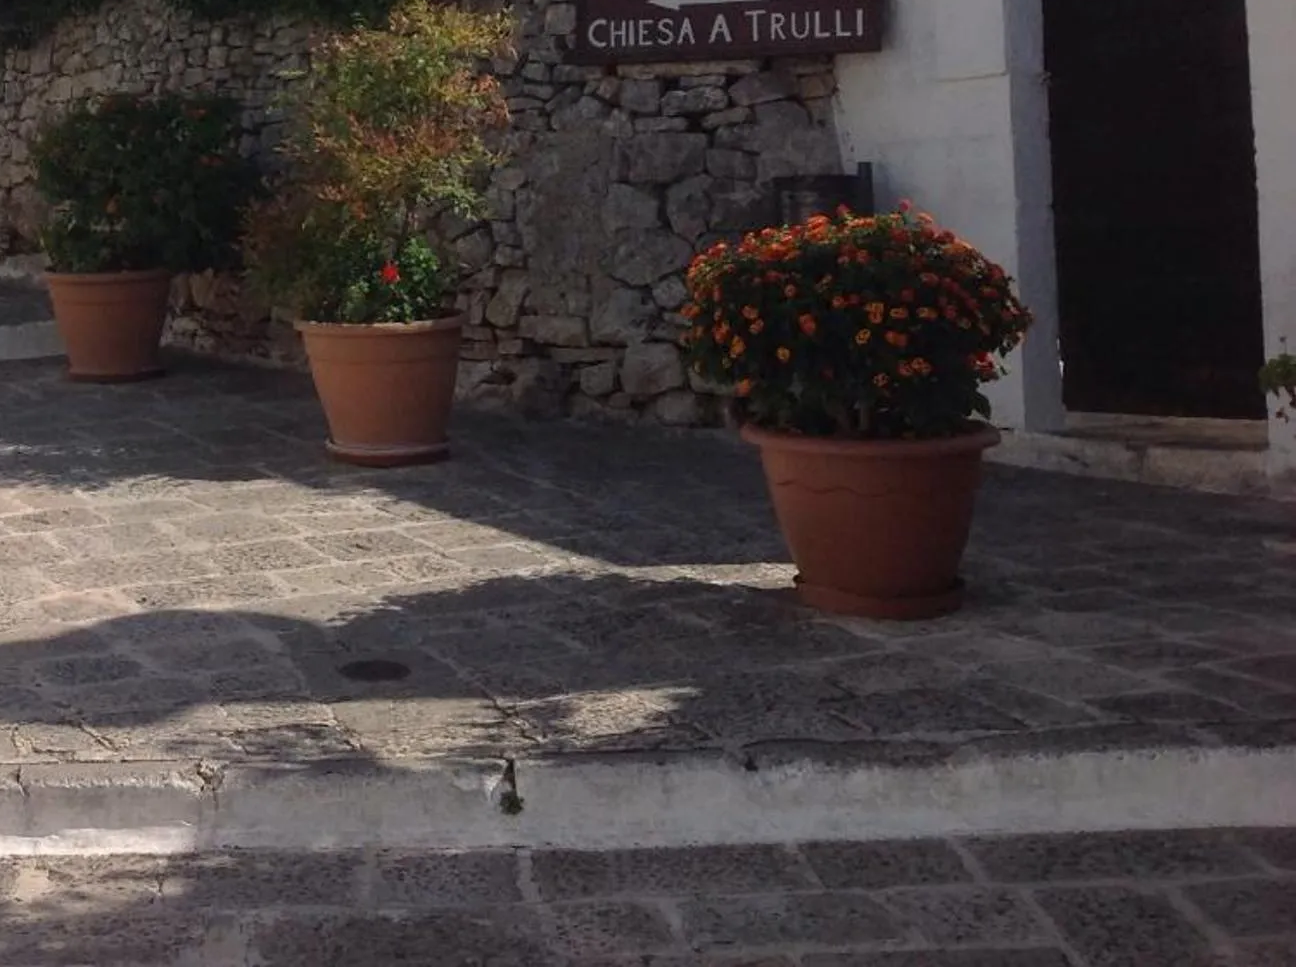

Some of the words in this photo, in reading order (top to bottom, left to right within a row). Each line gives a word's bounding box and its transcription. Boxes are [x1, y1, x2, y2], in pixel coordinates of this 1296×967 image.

[588, 18, 696, 48] CHIESA
[709, 14, 732, 43] A
[745, 9, 864, 41] TRULLI
